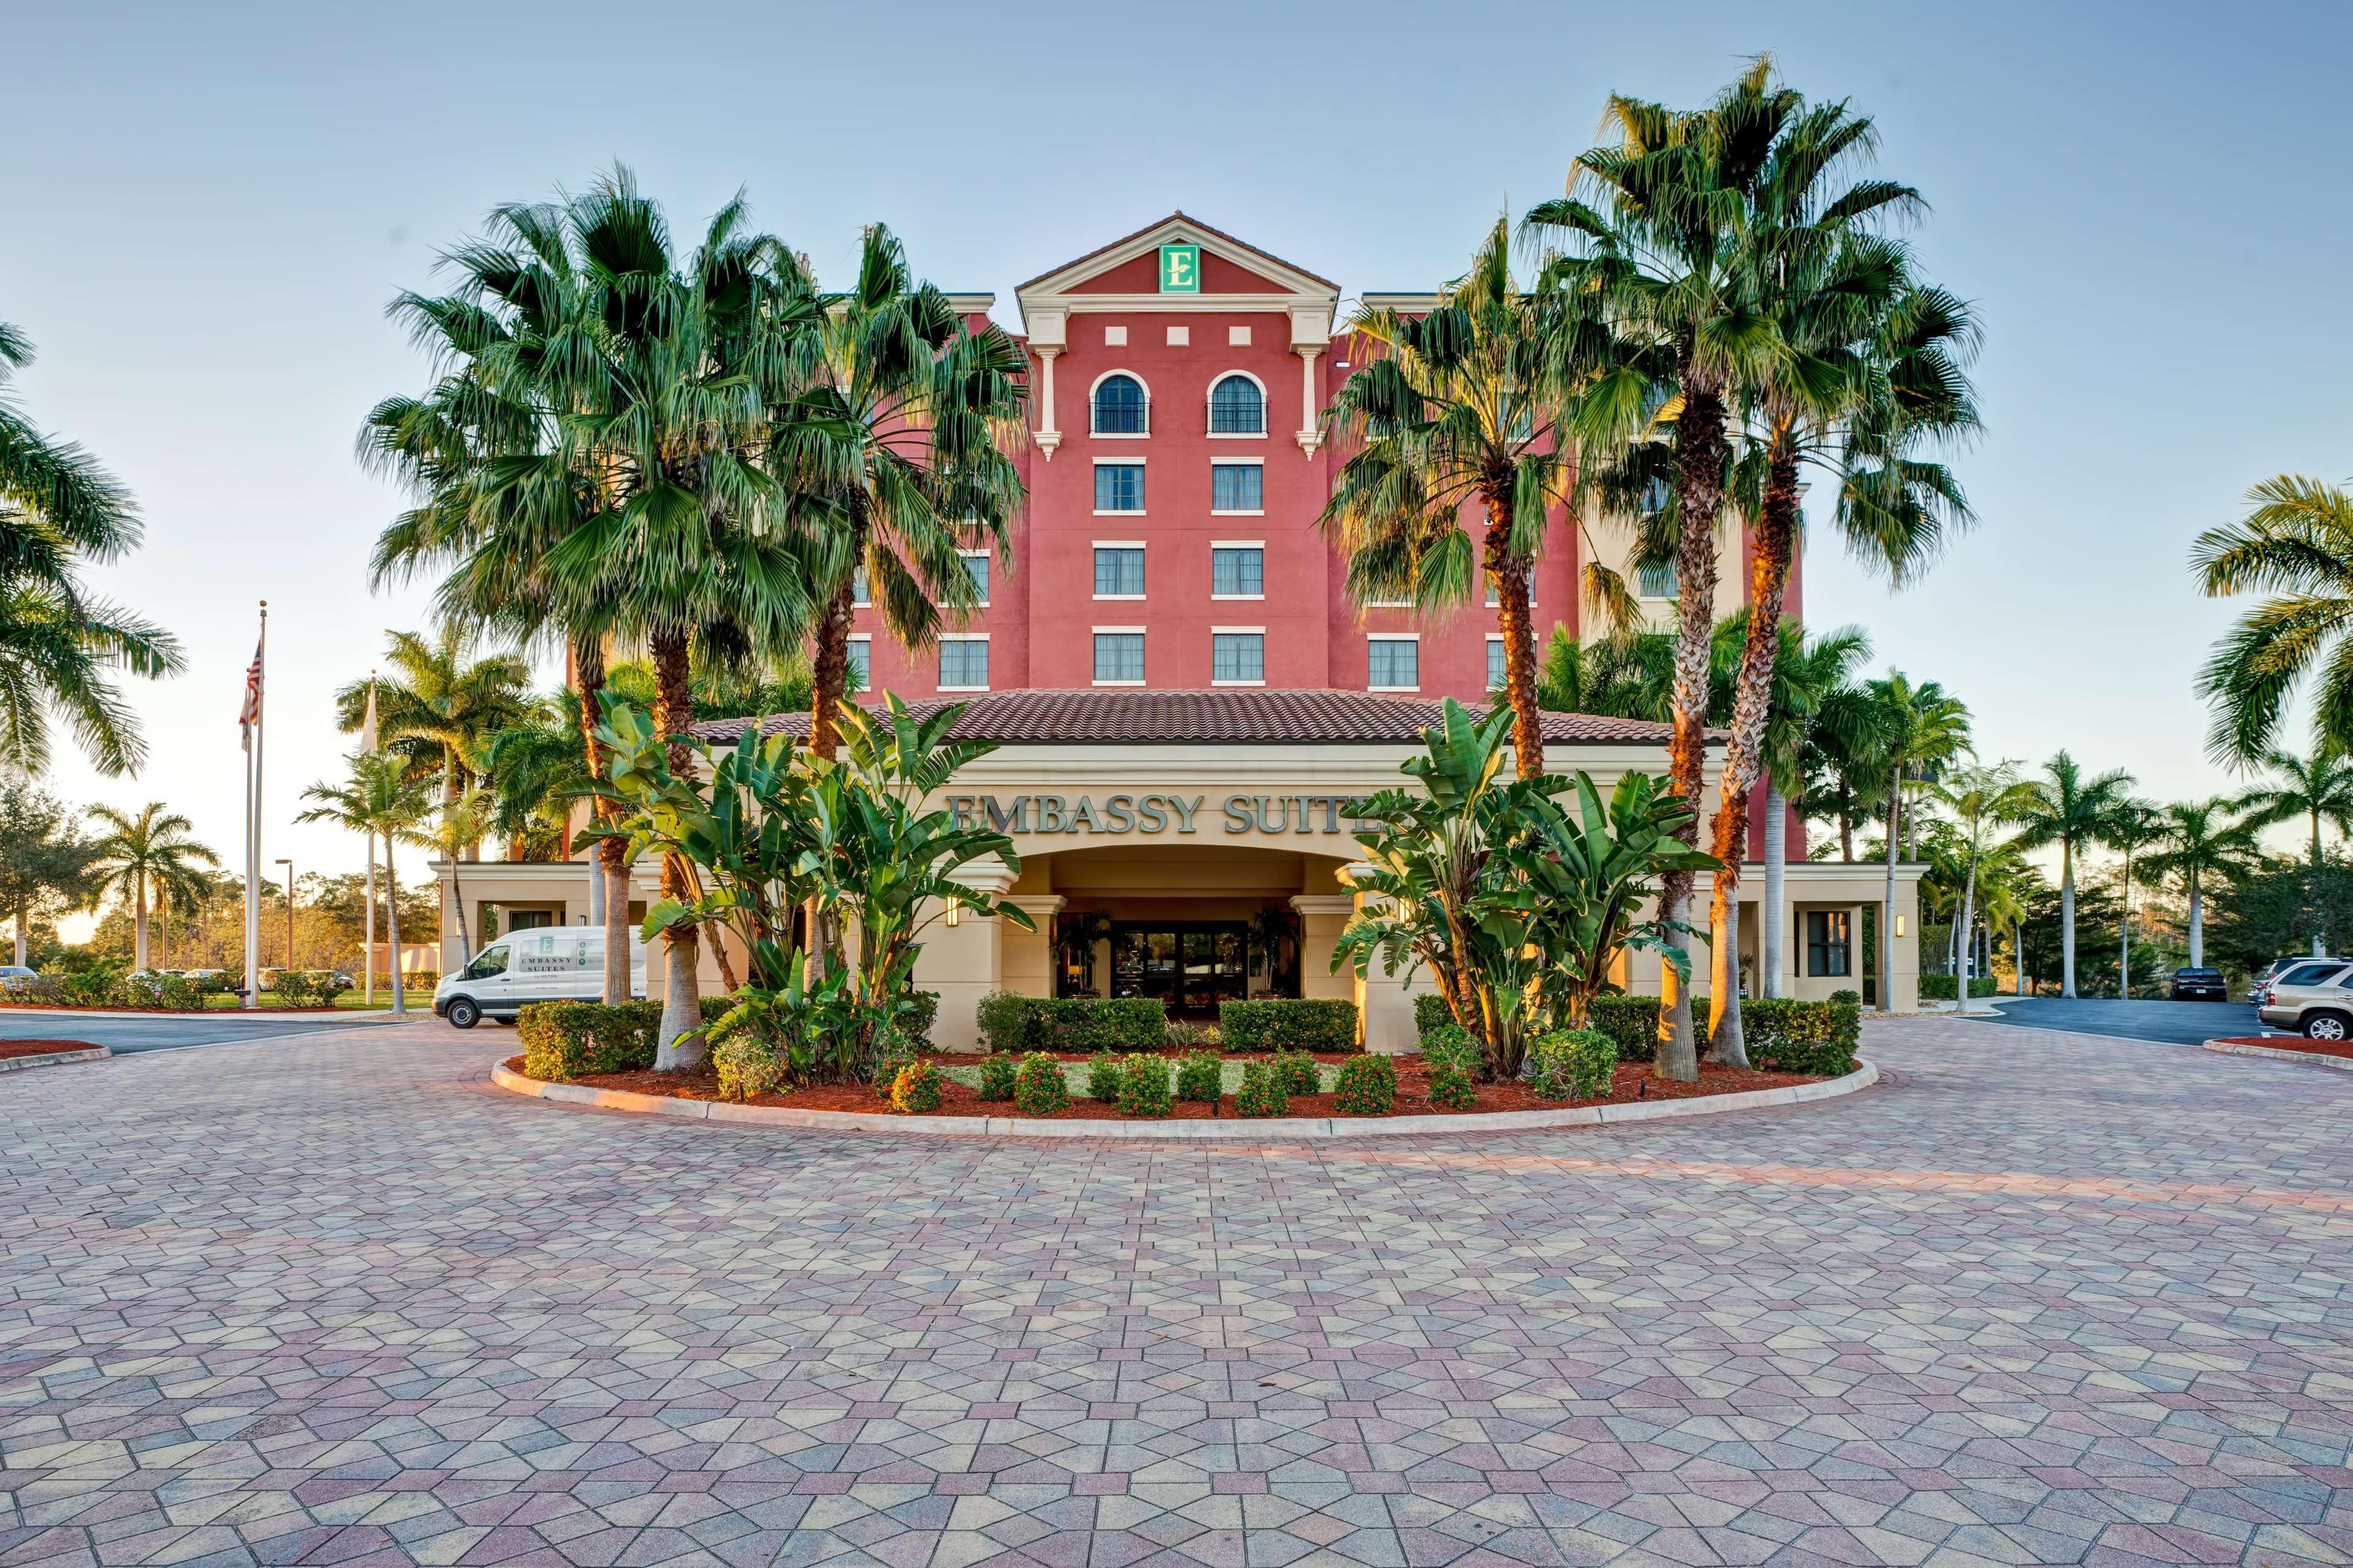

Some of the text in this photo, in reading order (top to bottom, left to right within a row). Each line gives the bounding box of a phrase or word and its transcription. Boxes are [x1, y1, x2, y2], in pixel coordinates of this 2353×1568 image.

[1167, 252, 1192, 286] E
[946, 795, 1412, 833] EMBASSY SUITE
